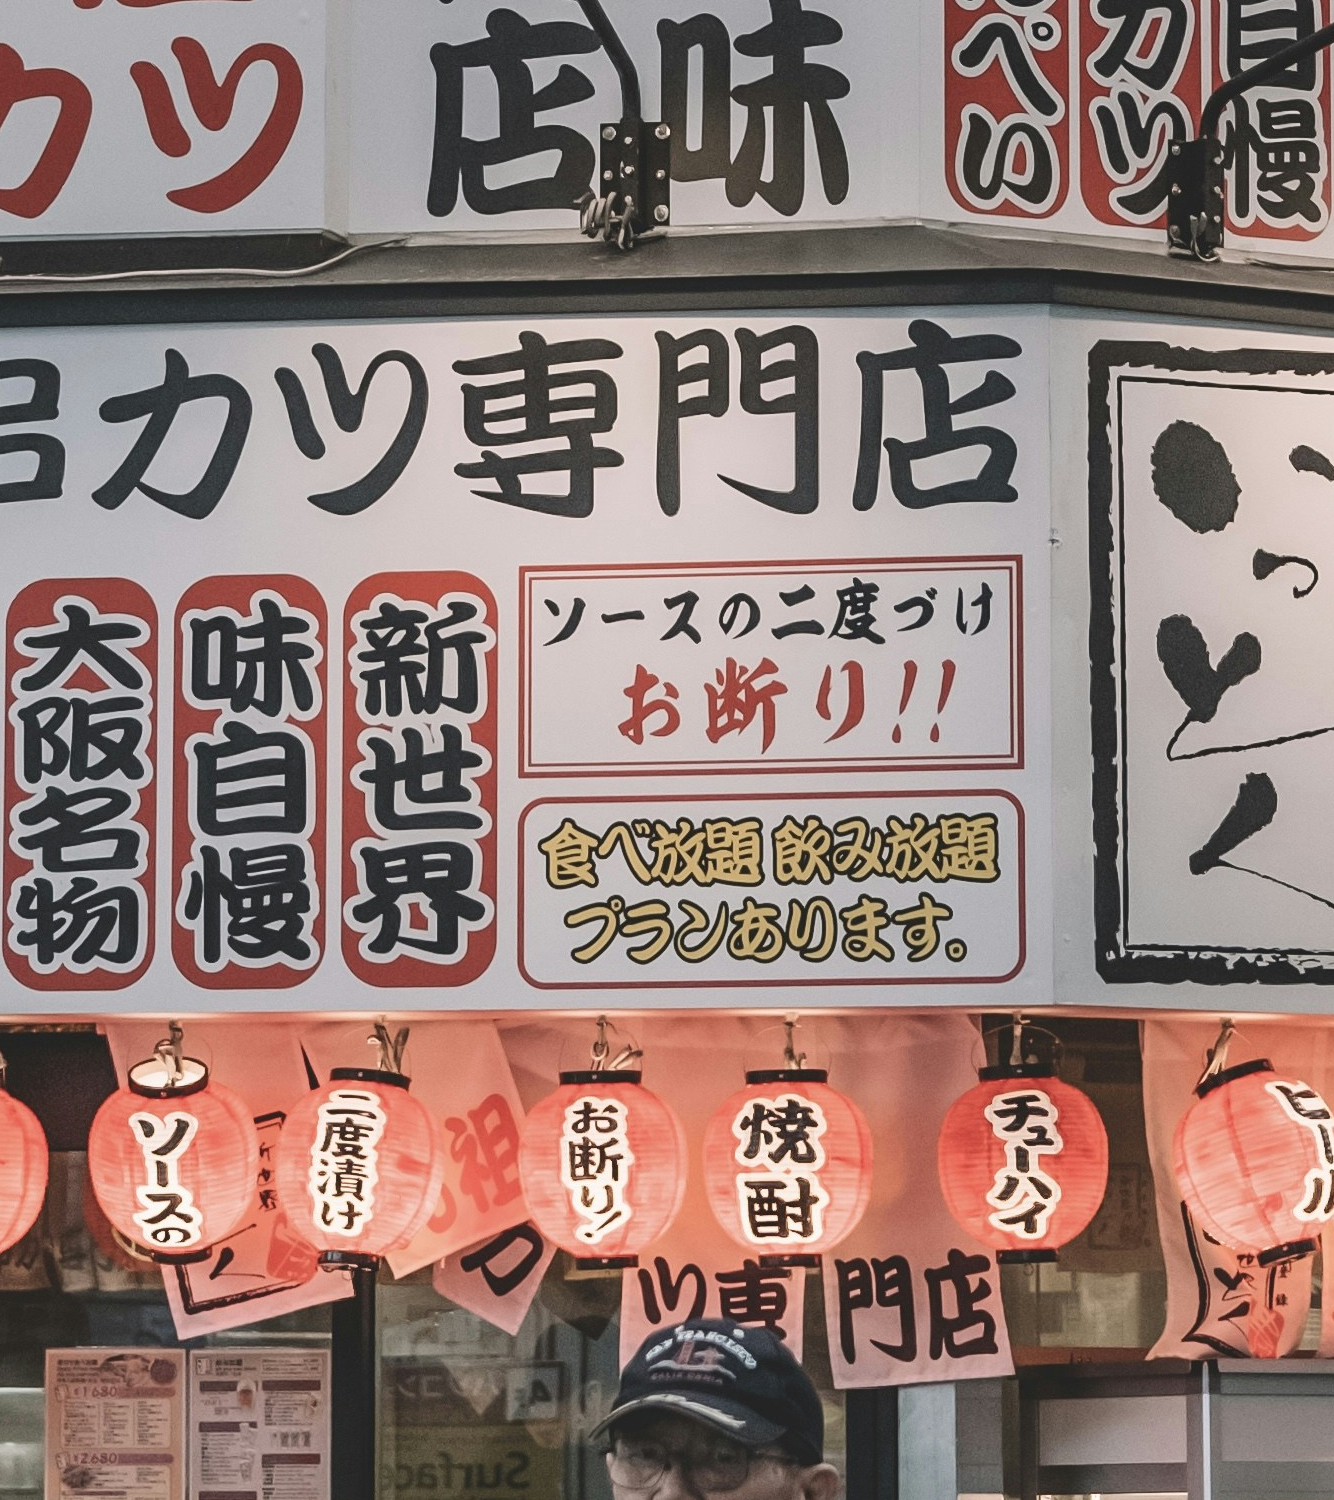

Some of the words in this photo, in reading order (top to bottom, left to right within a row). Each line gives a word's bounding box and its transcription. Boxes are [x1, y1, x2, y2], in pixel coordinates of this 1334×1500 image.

[542, 577, 994, 647] ソースの二度づけ
[16, 603, 142, 965] 大阪名物
[185, 598, 315, 963] 味自慢
[352, 600, 487, 957] 新世界
[540, 817, 764, 887] 食べ放題
[773, 813, 1002, 884] 飲み放題
[565, 897, 968, 965] プランあります。
[135, 1118, 198, 1245] ソースの
[316, 1092, 376, 1231] 二度漬け
[739, 1099, 821, 1239] 焼酎
[993, 1094, 1056, 1235] チューハイ
